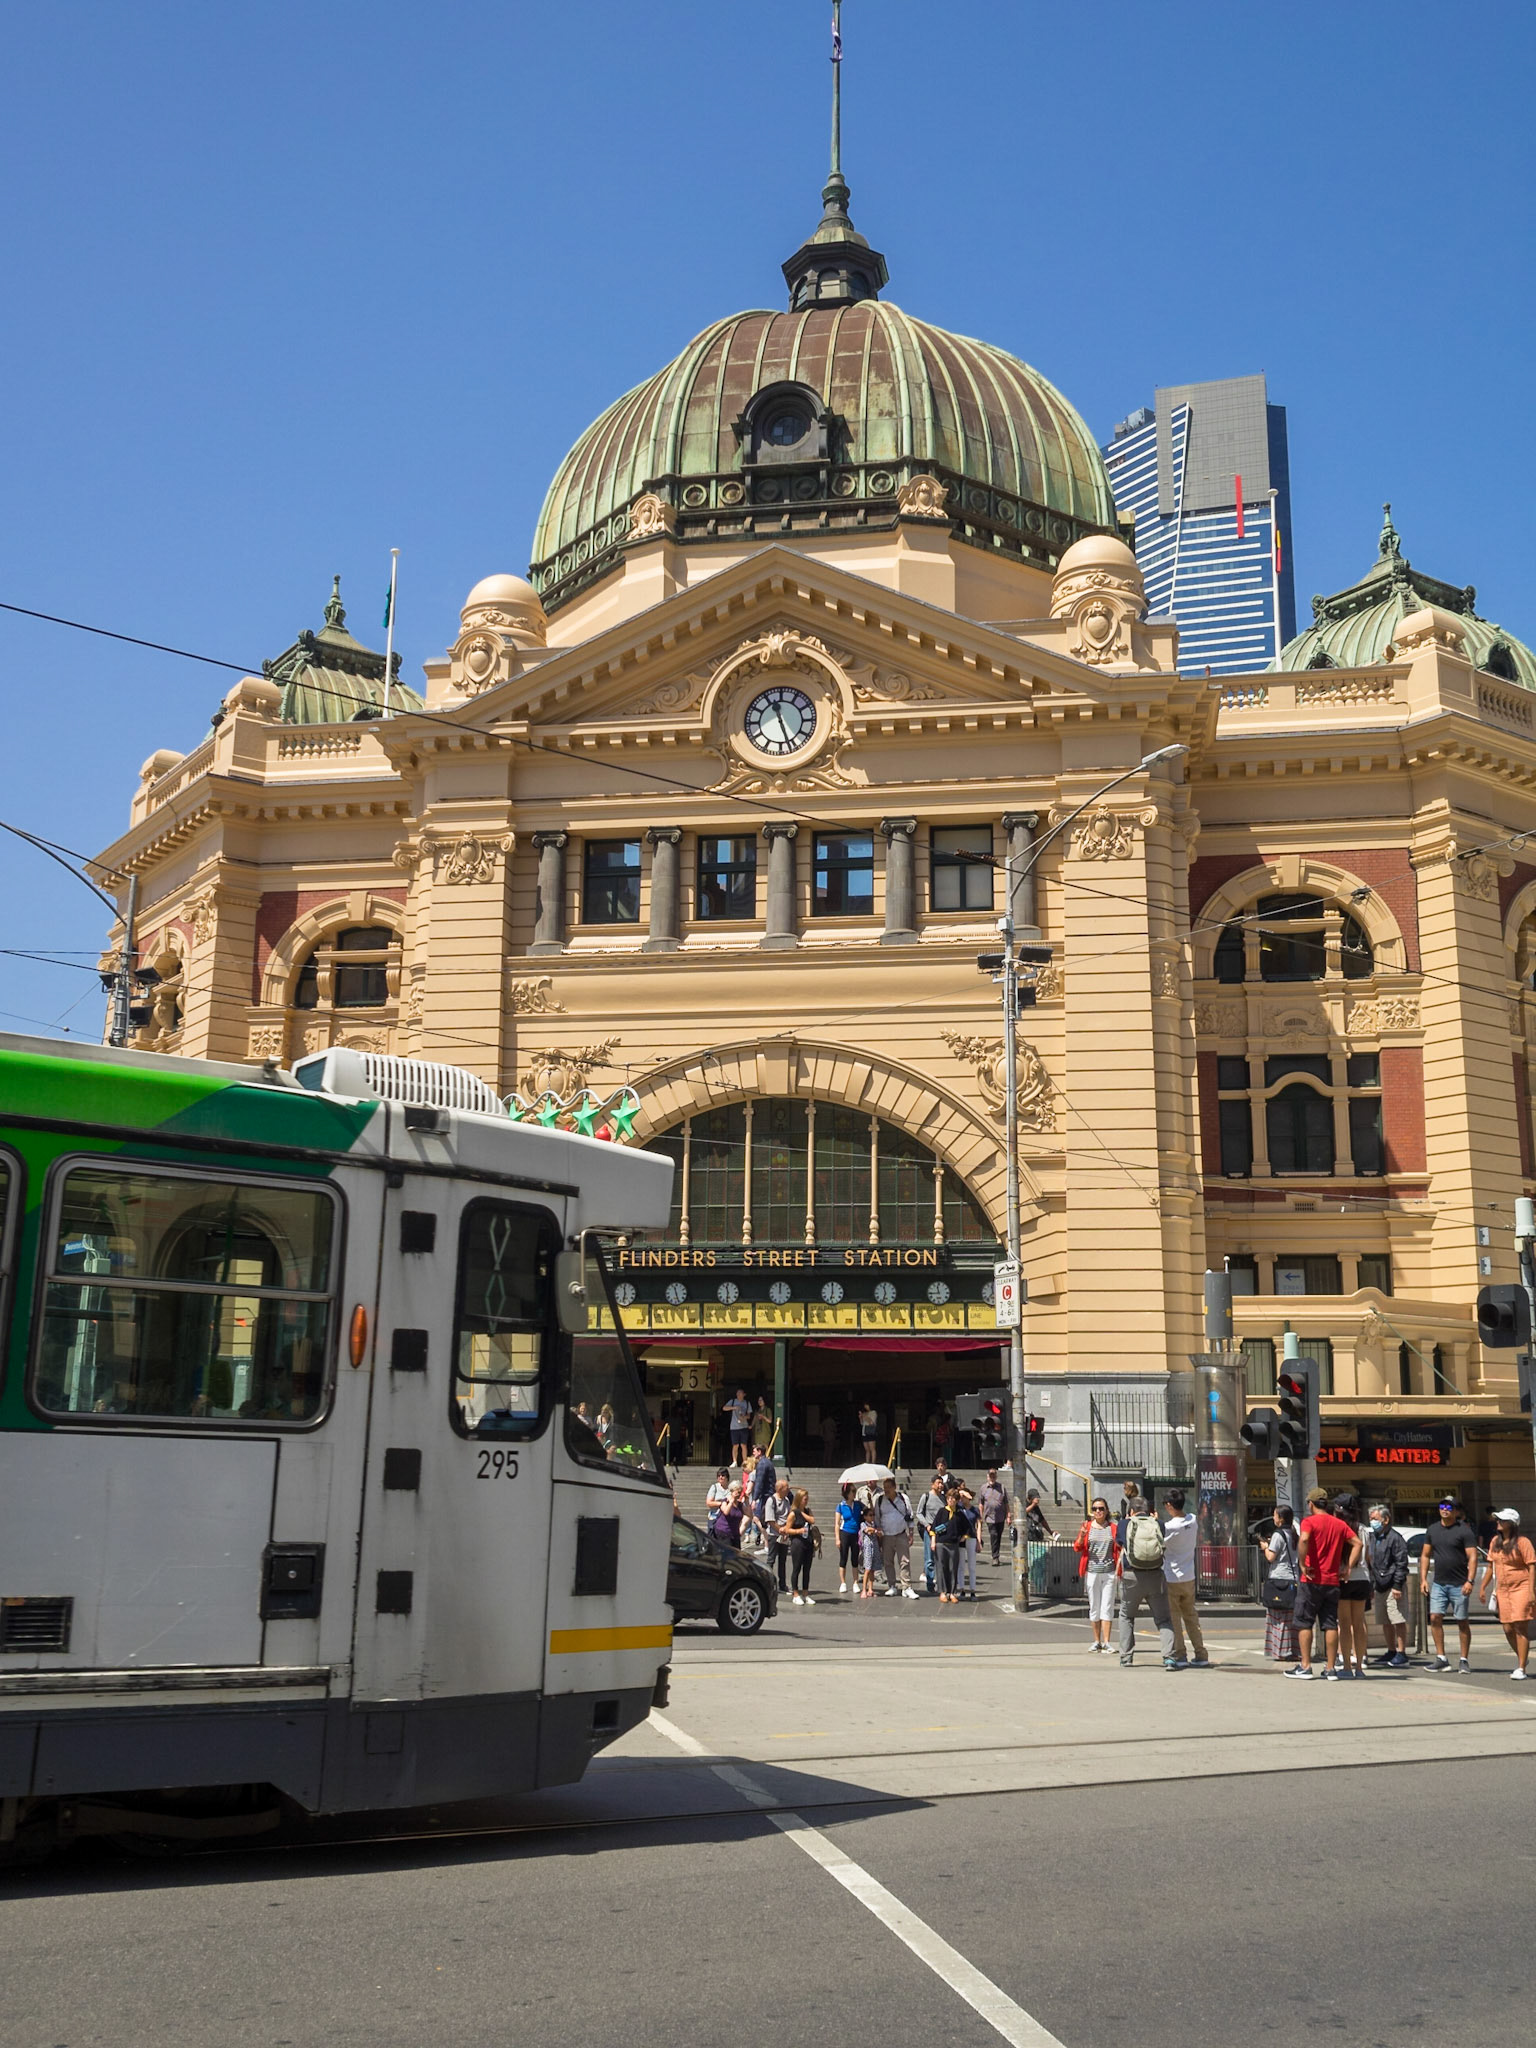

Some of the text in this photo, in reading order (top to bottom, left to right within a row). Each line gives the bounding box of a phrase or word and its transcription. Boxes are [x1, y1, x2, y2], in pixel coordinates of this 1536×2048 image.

[619, 1249, 937, 1267] FLINDERS STREET STATION
[1002, 1285, 1012, 1300] C
[1314, 1447, 1441, 1464] CITY HATTERS
[477, 1450, 519, 1479] 295
[1200, 1471, 1227, 1480] MAKE
[1200, 1480, 1233, 1490] MERRY
